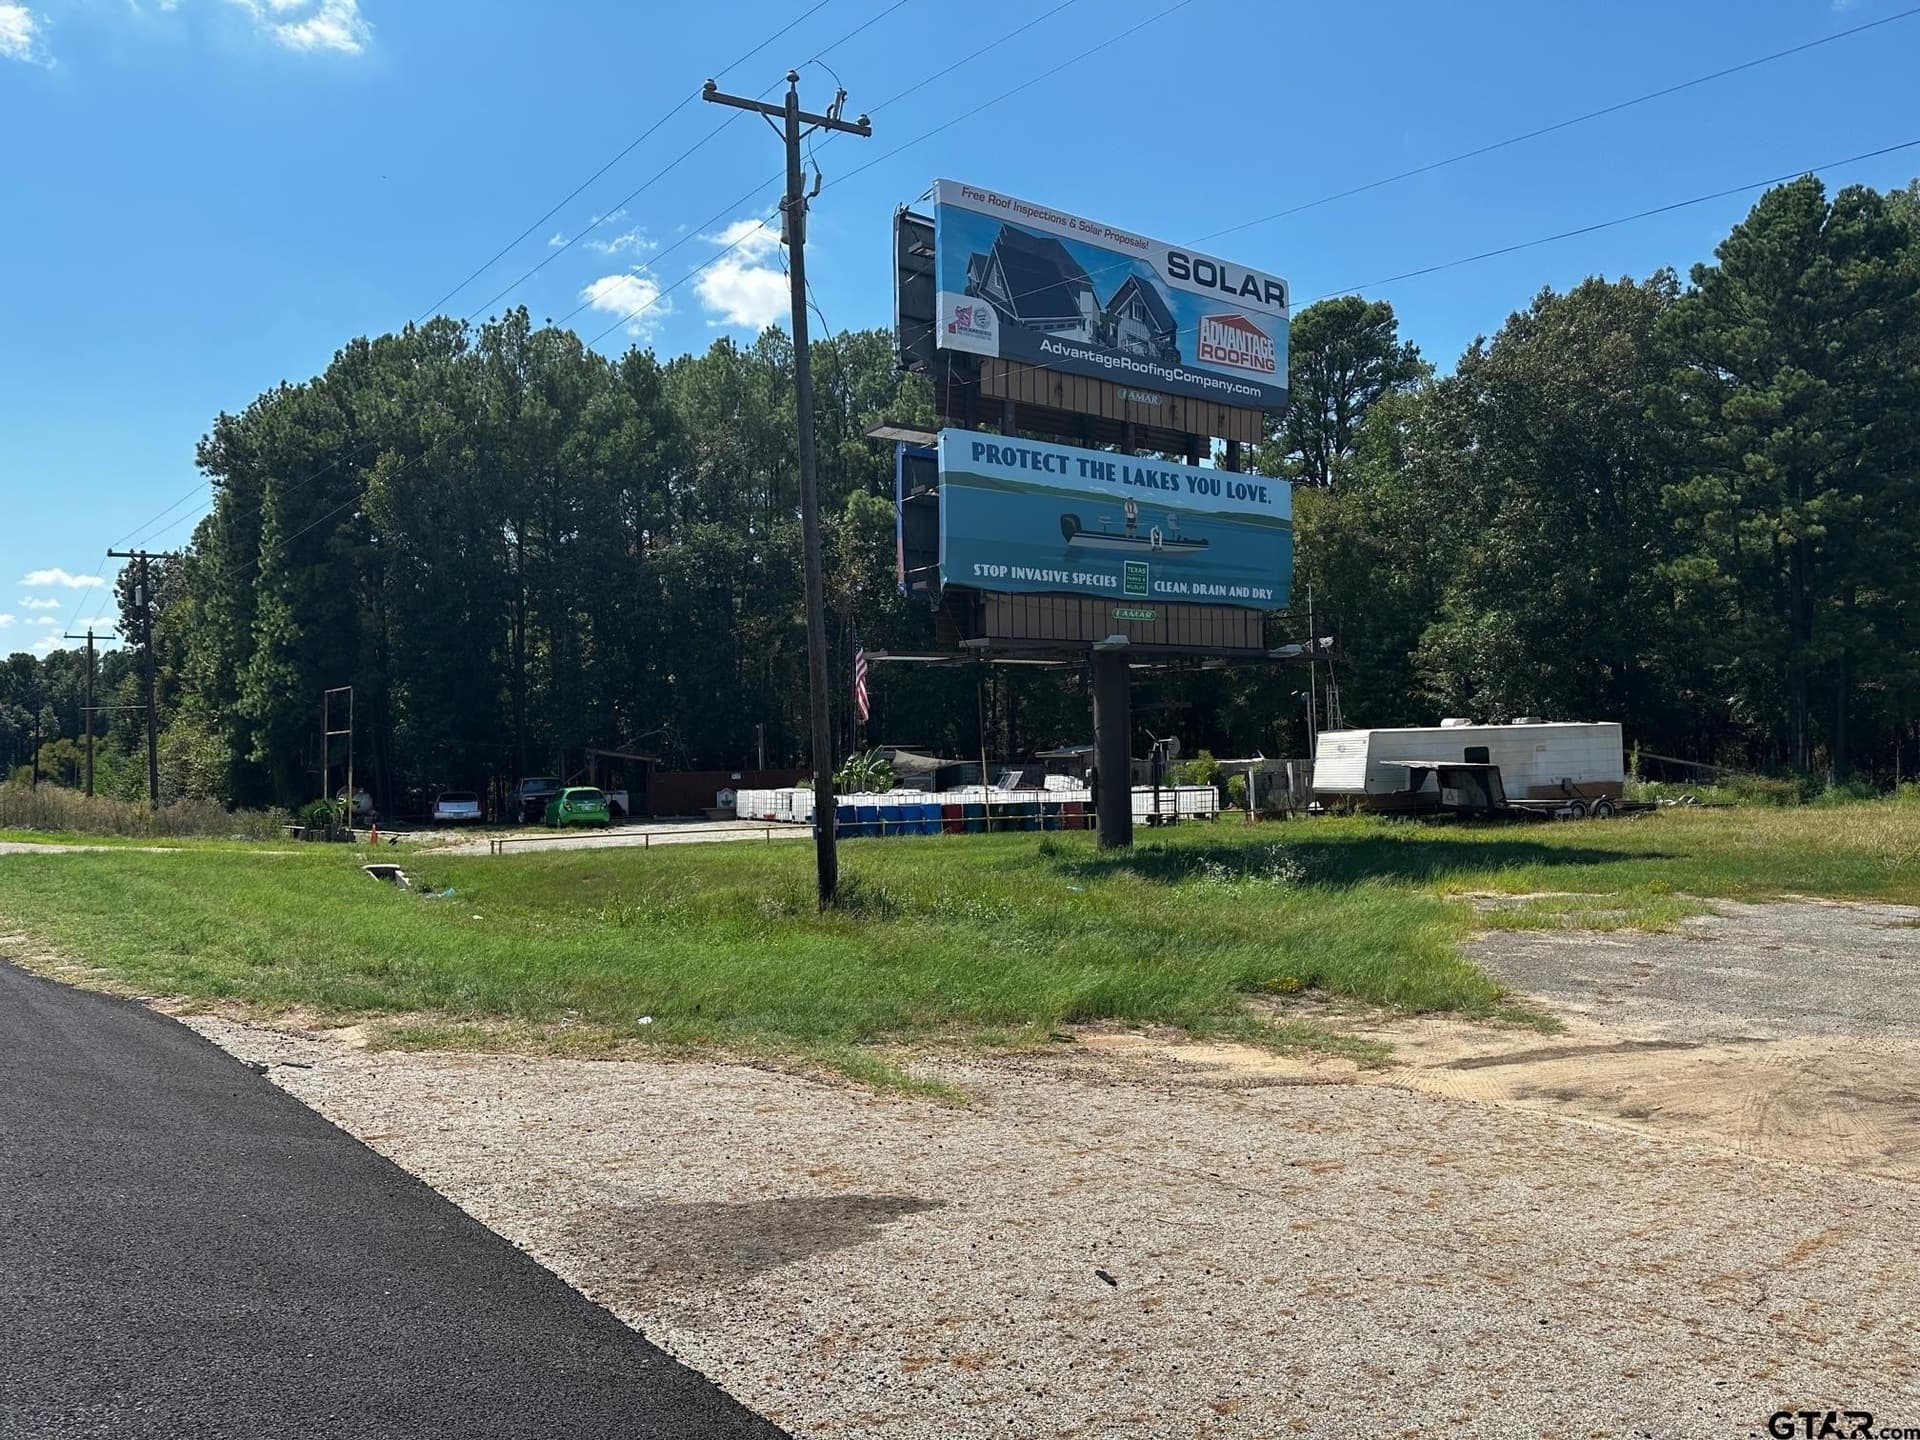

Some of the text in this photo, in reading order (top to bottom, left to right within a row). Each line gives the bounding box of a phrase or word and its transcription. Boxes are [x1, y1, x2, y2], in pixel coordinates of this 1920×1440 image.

[961, 186, 1150, 250] Free Roof Inspections & Solar Proposals!
[1167, 251, 1286, 310] SOLAR
[1200, 318, 1275, 358] ADVANTAGE
[1201, 342, 1276, 371] ROOFING
[1040, 339, 1262, 399] AdvantageRoofingCompany.com
[972, 441, 1272, 505] PROTECT THE LAKES YOU LOVE.
[973, 563, 1007, 578] STOP
[1011, 567, 1069, 584] INVASIVE
[1072, 572, 1117, 588] SPECIES
[1127, 566, 1146, 575] TEXAS
[1154, 580, 1190, 595] CLEAN,
[1192, 583, 1226, 597] DRAIN
[1229, 586, 1250, 598] AND
[1252, 587, 1273, 600] DRY
